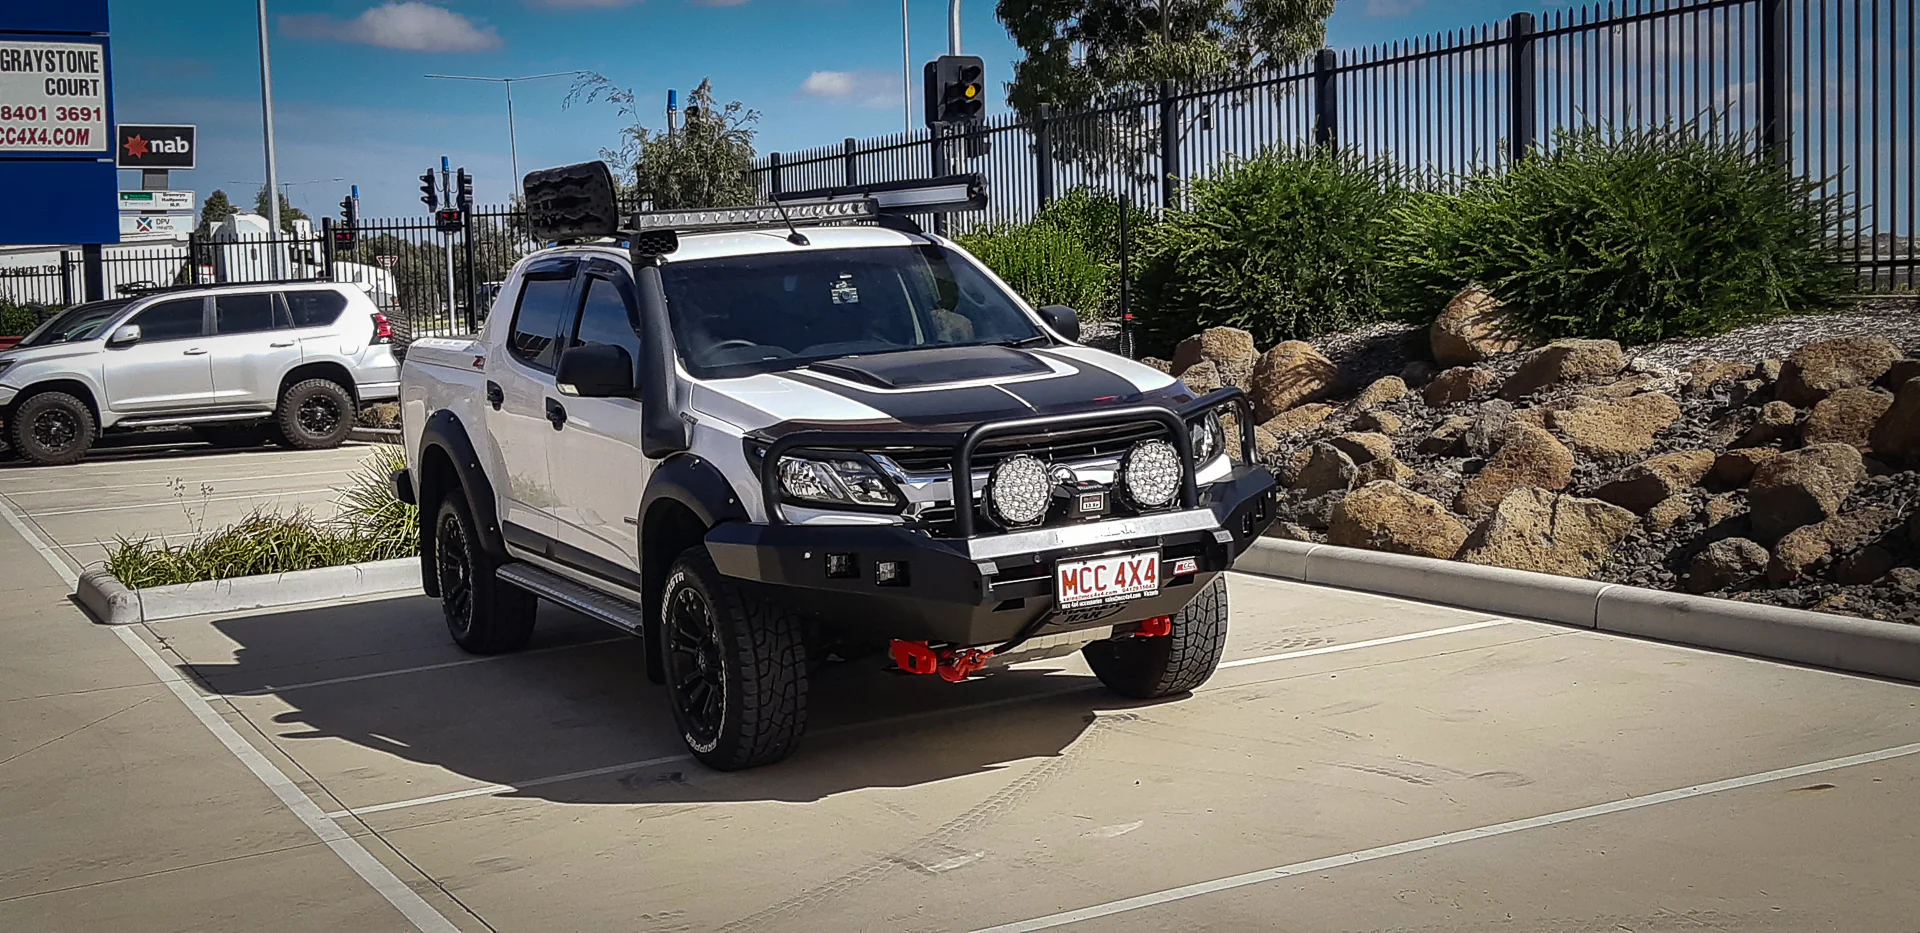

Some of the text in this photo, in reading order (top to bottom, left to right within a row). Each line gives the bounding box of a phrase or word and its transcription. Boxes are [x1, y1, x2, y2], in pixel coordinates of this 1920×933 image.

[1, 48, 99, 73] GRAYSTONE
[45, 78, 100, 96] COURT
[1, 106, 102, 122] 8401 3691
[151, 136, 189, 153] nab
[1062, 557, 1156, 597] MCC 4X4
[685, 731, 717, 754] GRIPPER
